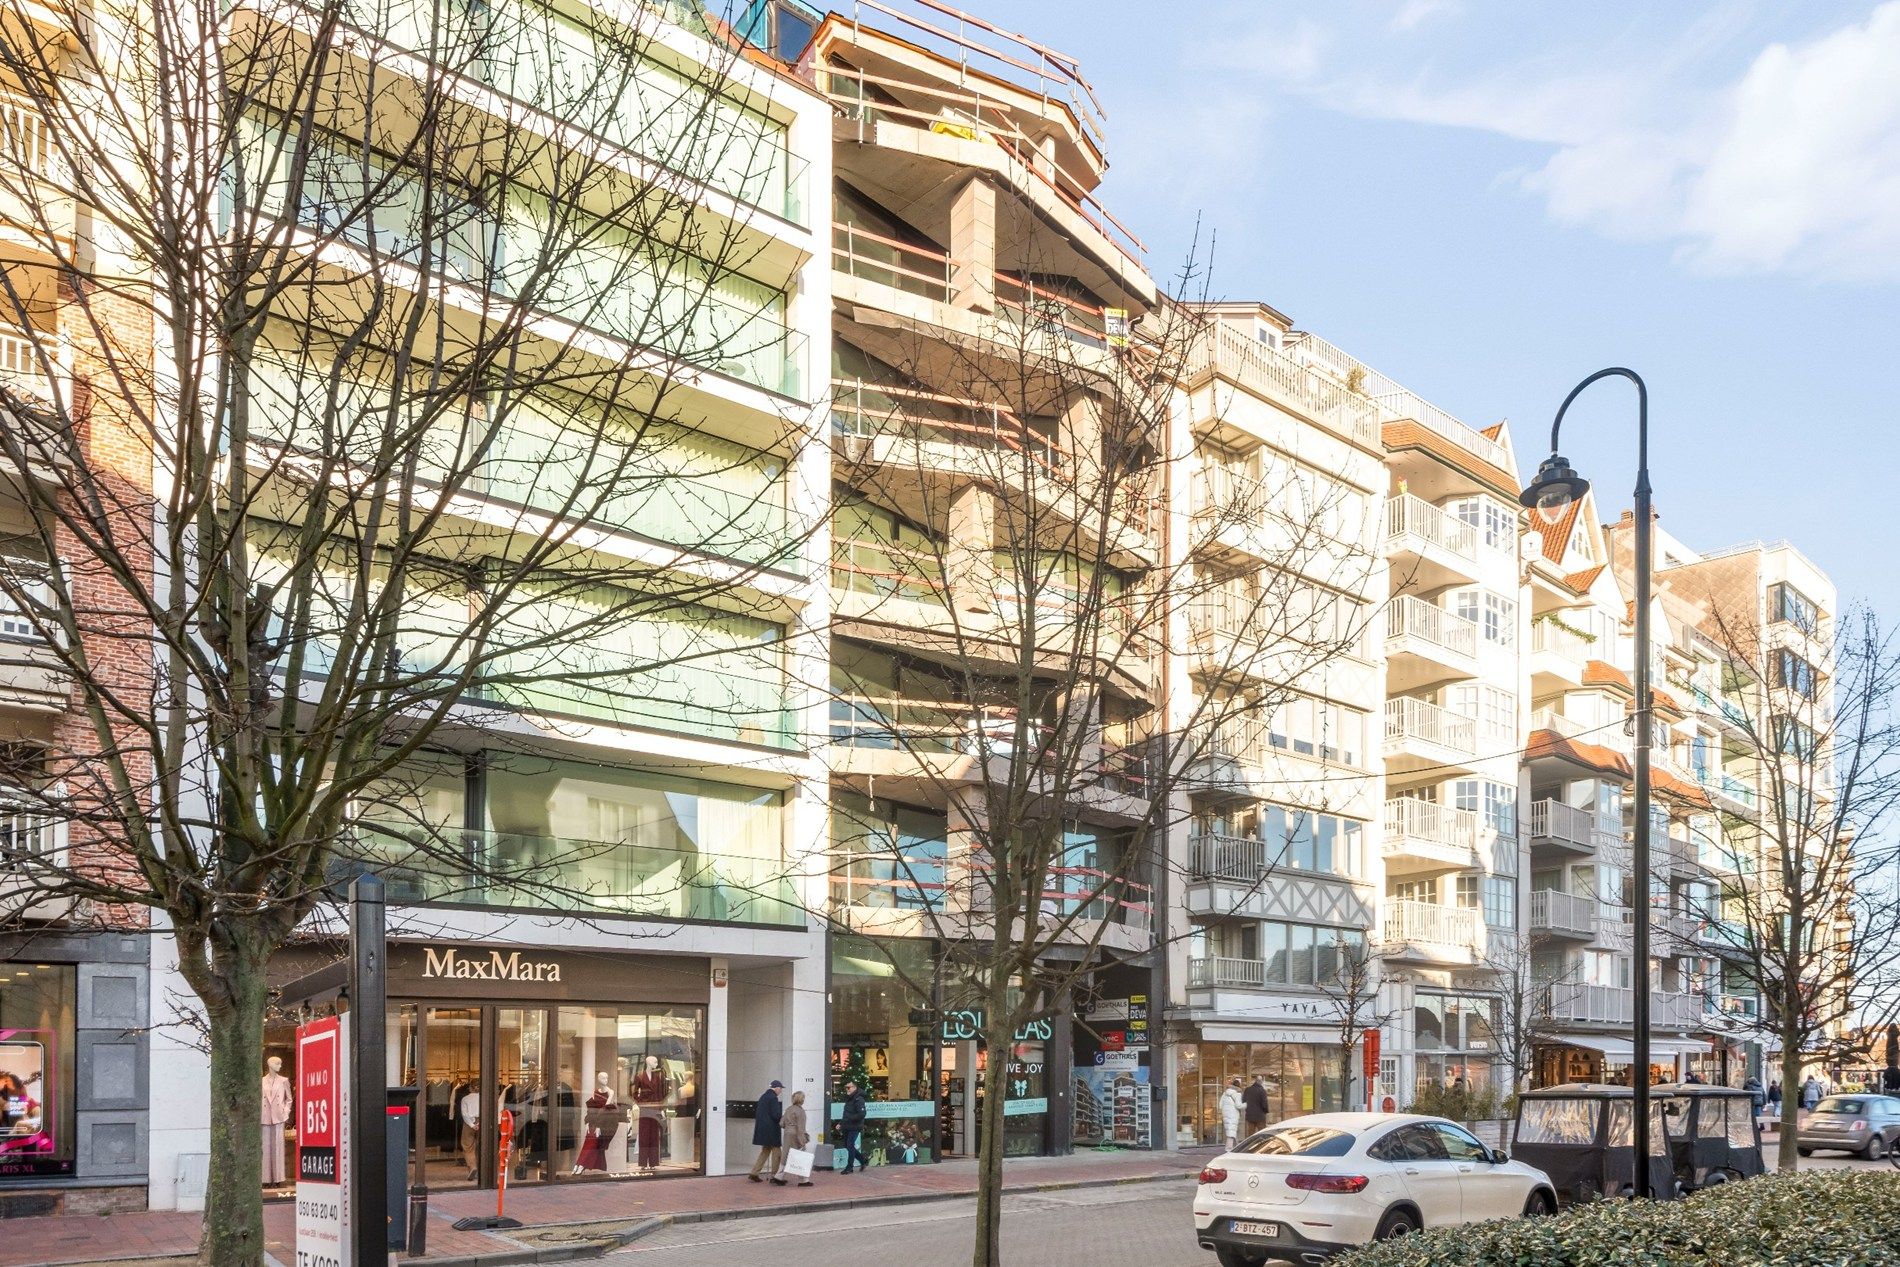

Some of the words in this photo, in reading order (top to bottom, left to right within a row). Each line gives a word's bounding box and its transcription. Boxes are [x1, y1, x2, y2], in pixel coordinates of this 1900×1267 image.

[422, 948, 561, 982] MaxMara
[1282, 1003, 1317, 1014] YAYA
[1271, 1032, 1306, 1041] YAYA
[1005, 1063, 1021, 1073] IVE
[1024, 1063, 1043, 1074] JOY
[306, 1069, 328, 1088] IMMO
[301, 1155, 334, 1175] GARAGE
[299, 1200, 309, 1217] 050
[311, 1202, 319, 1218] 63
[320, 1203, 328, 1219] 20
[330, 1204, 338, 1221] 40
